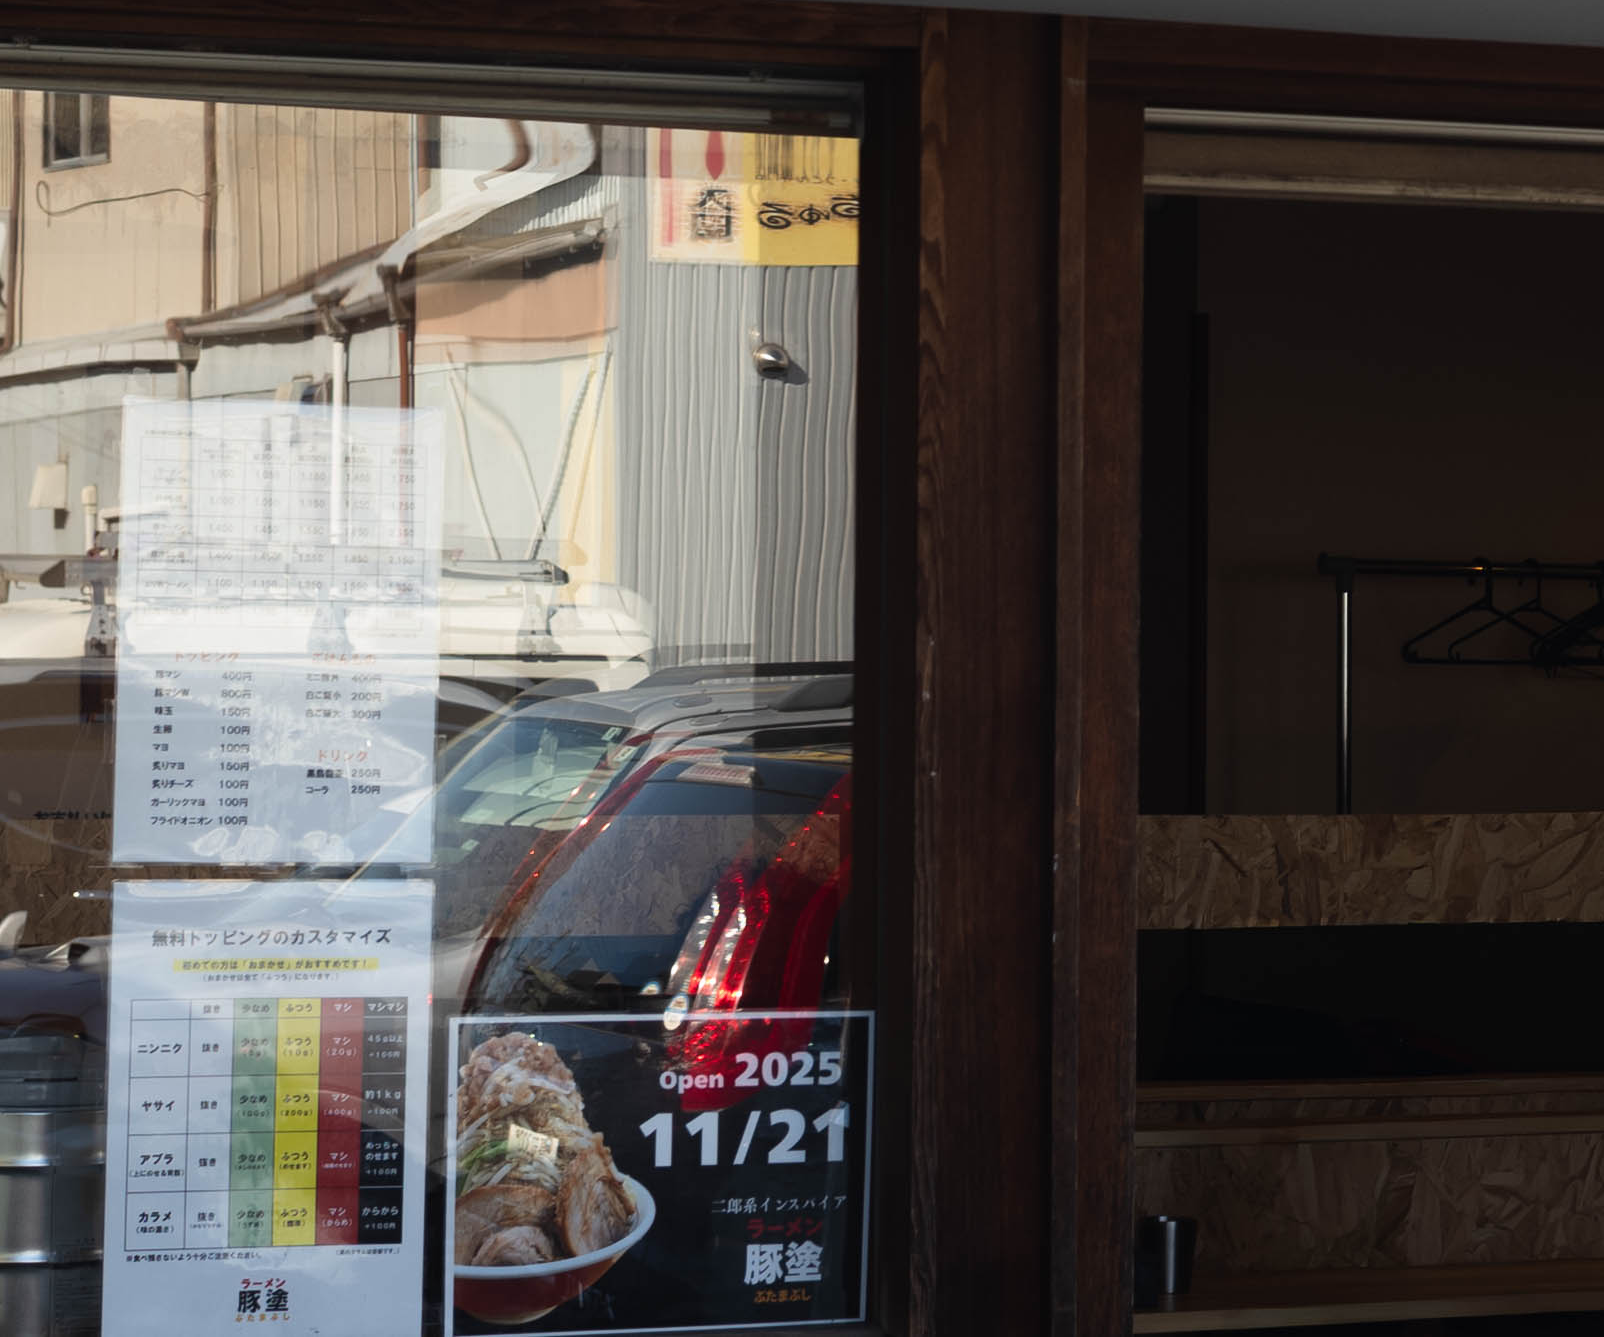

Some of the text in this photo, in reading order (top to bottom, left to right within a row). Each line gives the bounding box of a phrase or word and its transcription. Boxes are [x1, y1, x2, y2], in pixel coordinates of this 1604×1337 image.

[221, 726, 250, 735] 100円
[153, 743, 250, 753] マヨ 100円
[220, 762, 250, 771] 150円
[219, 780, 248, 789] 100円
[305, 785, 380, 794] コーラ 250円
[151, 798, 248, 807] ガーリックマヨ 100円
[151, 816, 247, 825] フライドオニオン 100円
[152, 928, 392, 947] 無料トッピングのカスタマイズ
[241, 1003, 270, 1014] 少なめ
[285, 1003, 313, 1013] ふつう
[334, 1002, 352, 1012] マシ
[367, 1002, 404, 1012] マシマシ
[137, 1043, 183, 1054] ニンニク
[285, 1037, 312, 1046] ふつう
[332, 1036, 351, 1045] マシ
[659, 1051, 842, 1094] Open 2025
[142, 1100, 176, 1112] ヤサイ
[239, 1094, 268, 1104] 少なめ
[283, 1094, 311, 1103] ふつう
[331, 1093, 350, 1102] マシ
[639, 1108, 845, 1167] 11/21
[139, 1153, 174, 1165] アブラ
[281, 1152, 309, 1161] ふつう
[329, 1152, 349, 1161] マシ
[711, 1194, 847, 1215] 二郎系インスパイア
[138, 1211, 172, 1223] カラメ
[281, 1208, 309, 1217] ふつう
[328, 1207, 346, 1216] マシ
[747, 1218, 822, 1238] ラーメン
[744, 1240, 823, 1285] 豚塗
[240, 1278, 286, 1289] ラーメン
[237, 1288, 289, 1313] 豚塗
[754, 1287, 811, 1303] ぶたまぶし
